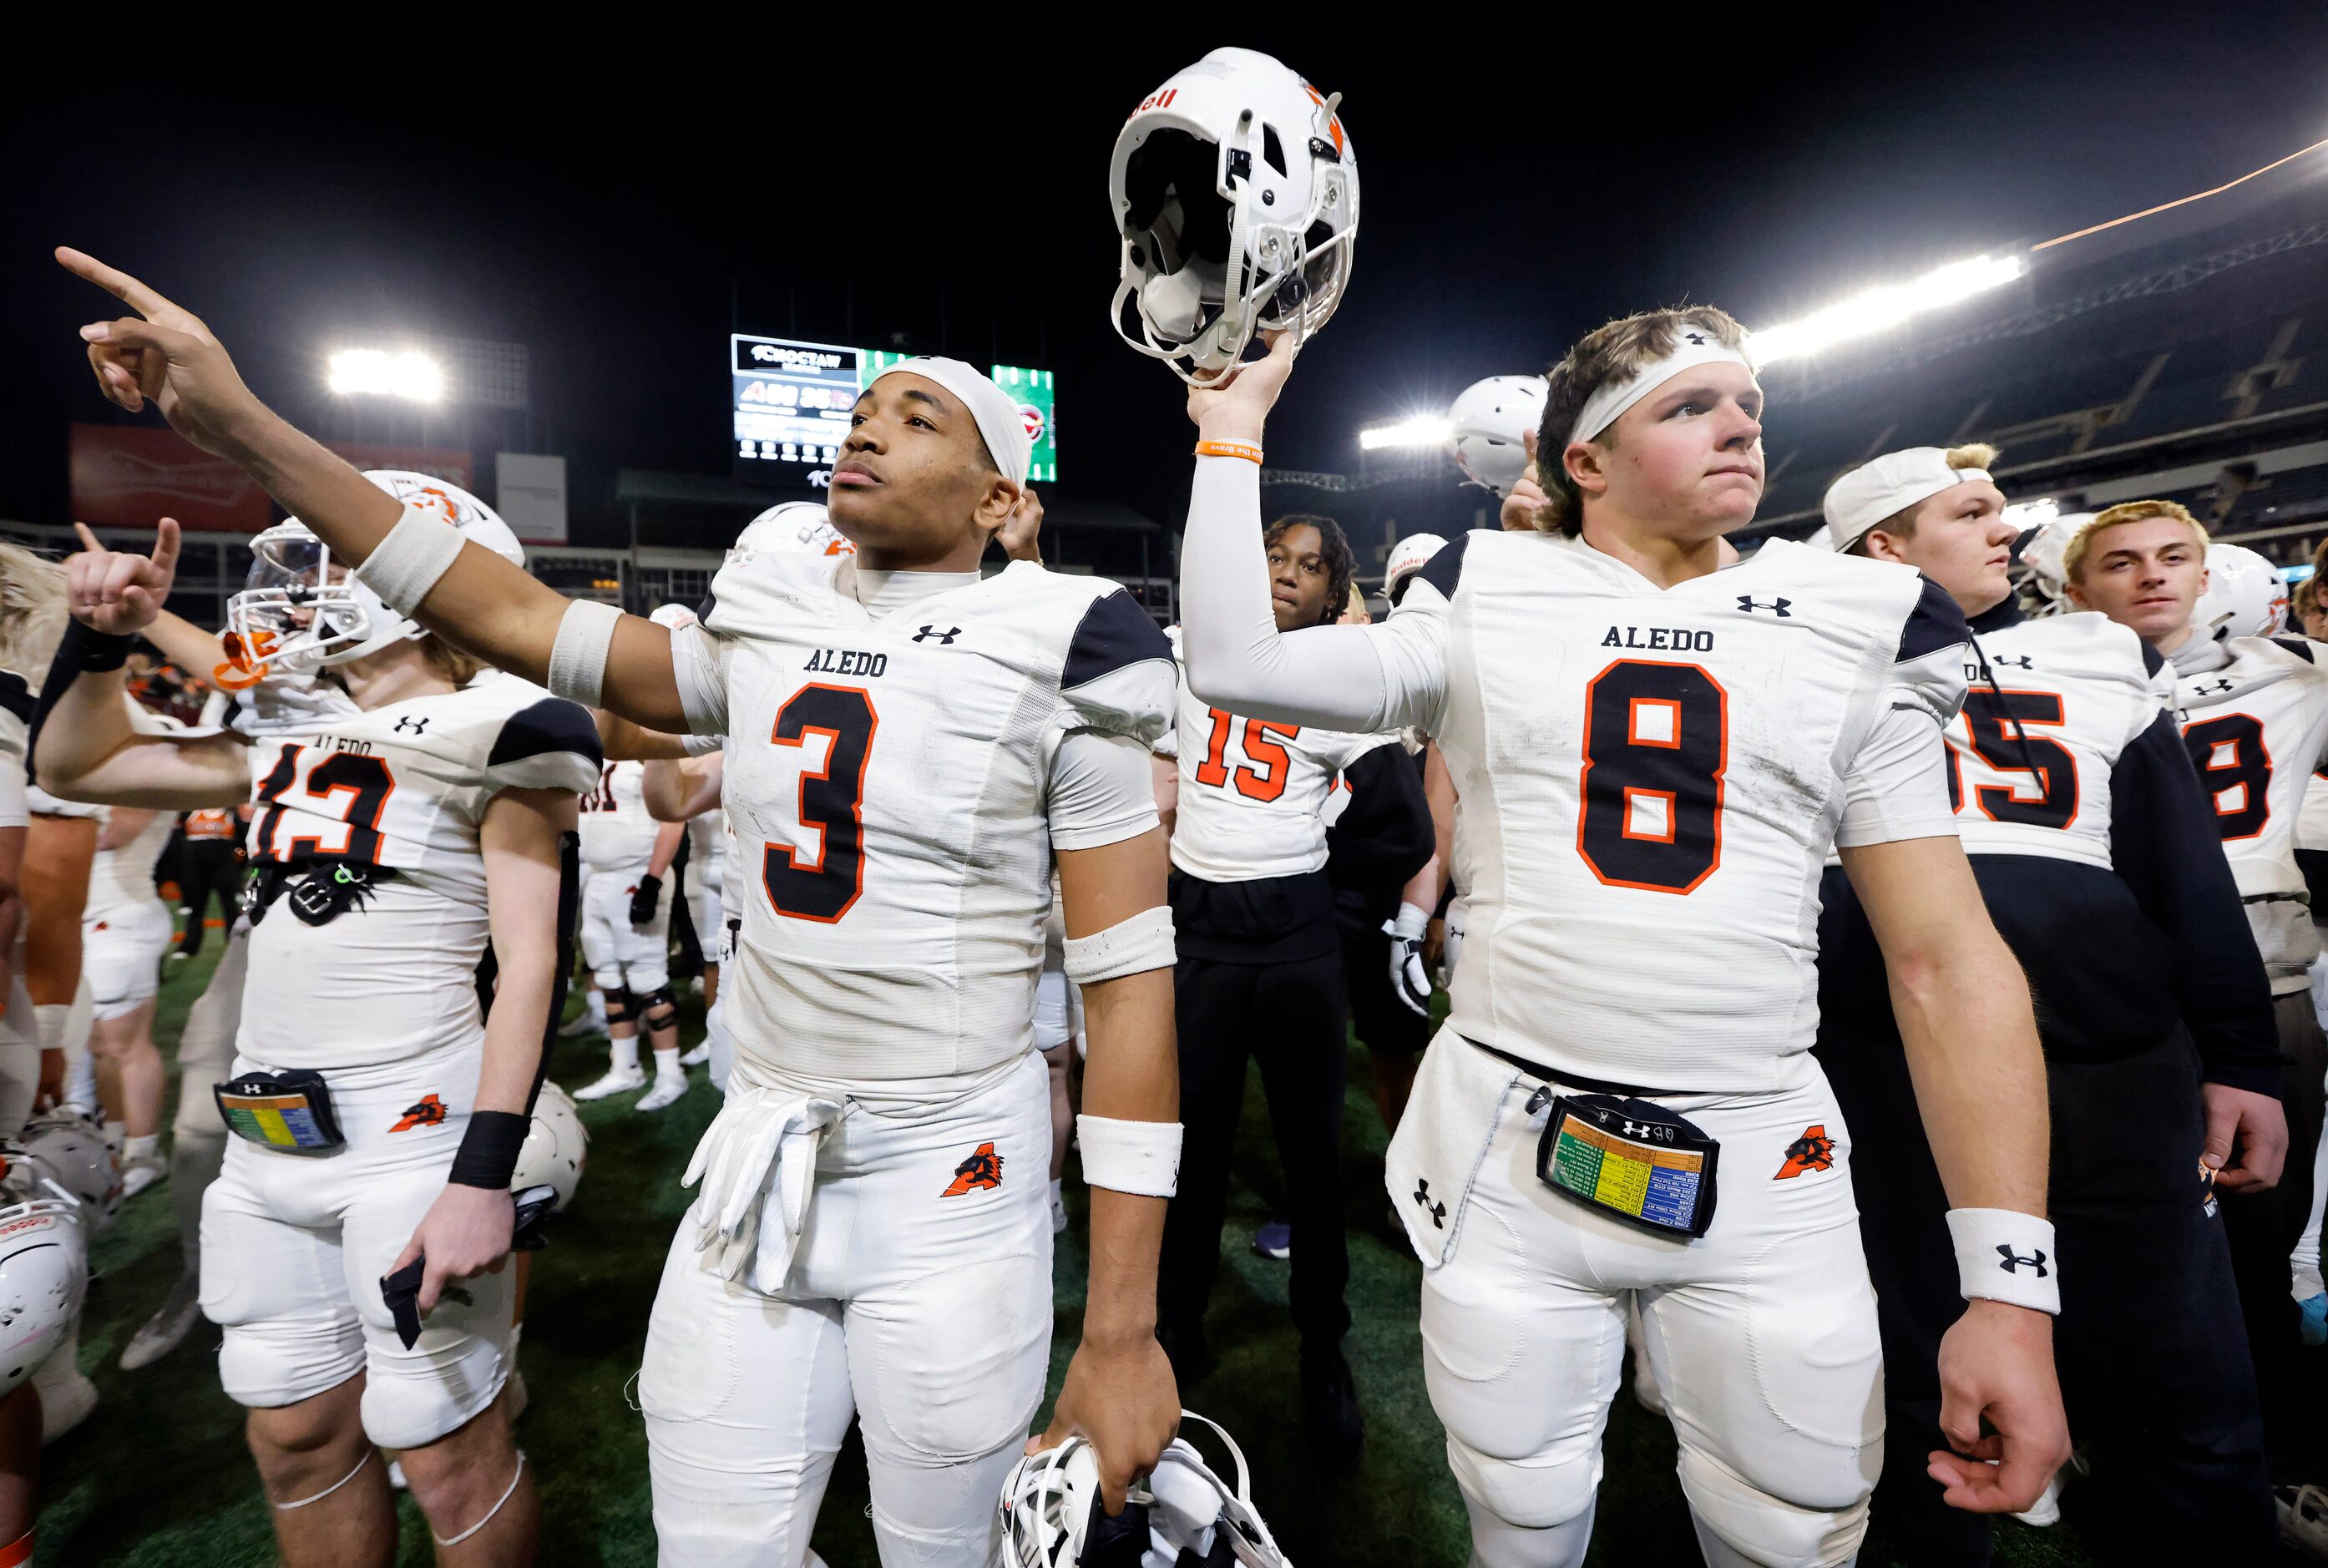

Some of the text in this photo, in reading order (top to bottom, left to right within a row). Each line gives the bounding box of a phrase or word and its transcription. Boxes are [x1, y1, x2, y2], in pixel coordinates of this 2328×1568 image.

[1210, 444, 1235, 453] Brave
[1237, 447, 1252, 456] the
[1601, 625, 1714, 654] ALEDO
[803, 648, 888, 678] ALEDO
[1195, 706, 1301, 803] 15
[1941, 685, 2081, 831] 5
[1576, 657, 1729, 896] 8
[762, 681, 879, 925] 3
[1652, 1125, 1674, 1143] QB
[1574, 1145, 1589, 1153] Down
